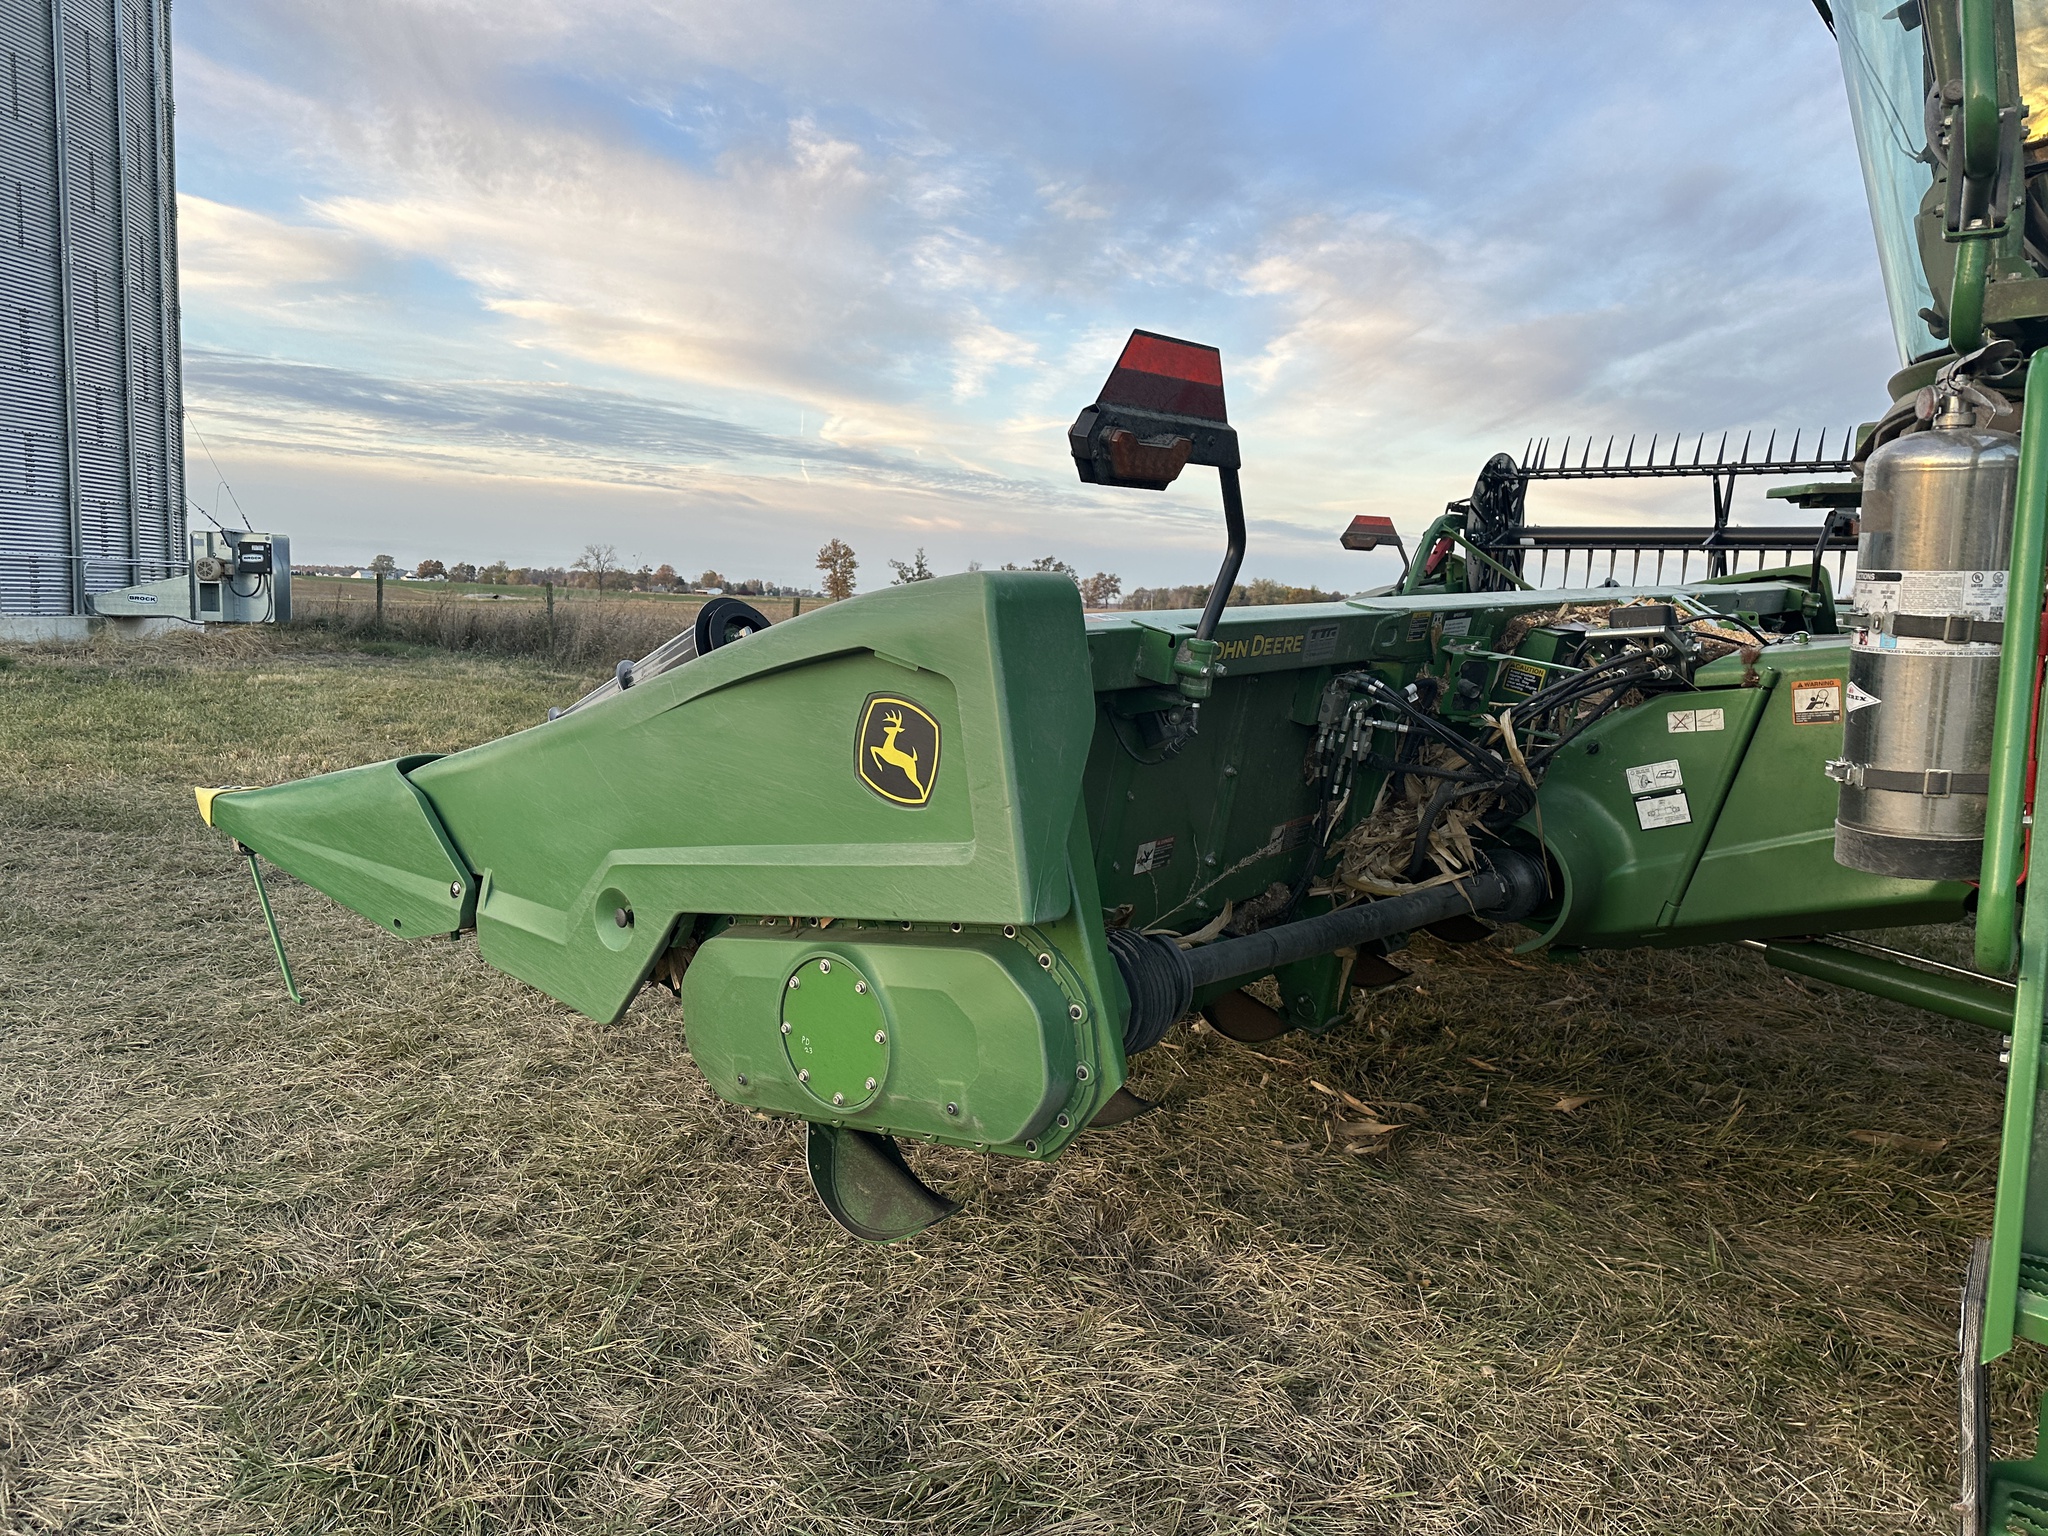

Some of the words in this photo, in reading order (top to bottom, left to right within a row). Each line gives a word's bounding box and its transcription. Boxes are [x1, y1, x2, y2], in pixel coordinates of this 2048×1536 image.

[1215, 639, 1249, 661] OHN
[1251, 634, 1304, 657] DEERE
[1516, 664, 1544, 675] CAUTION
